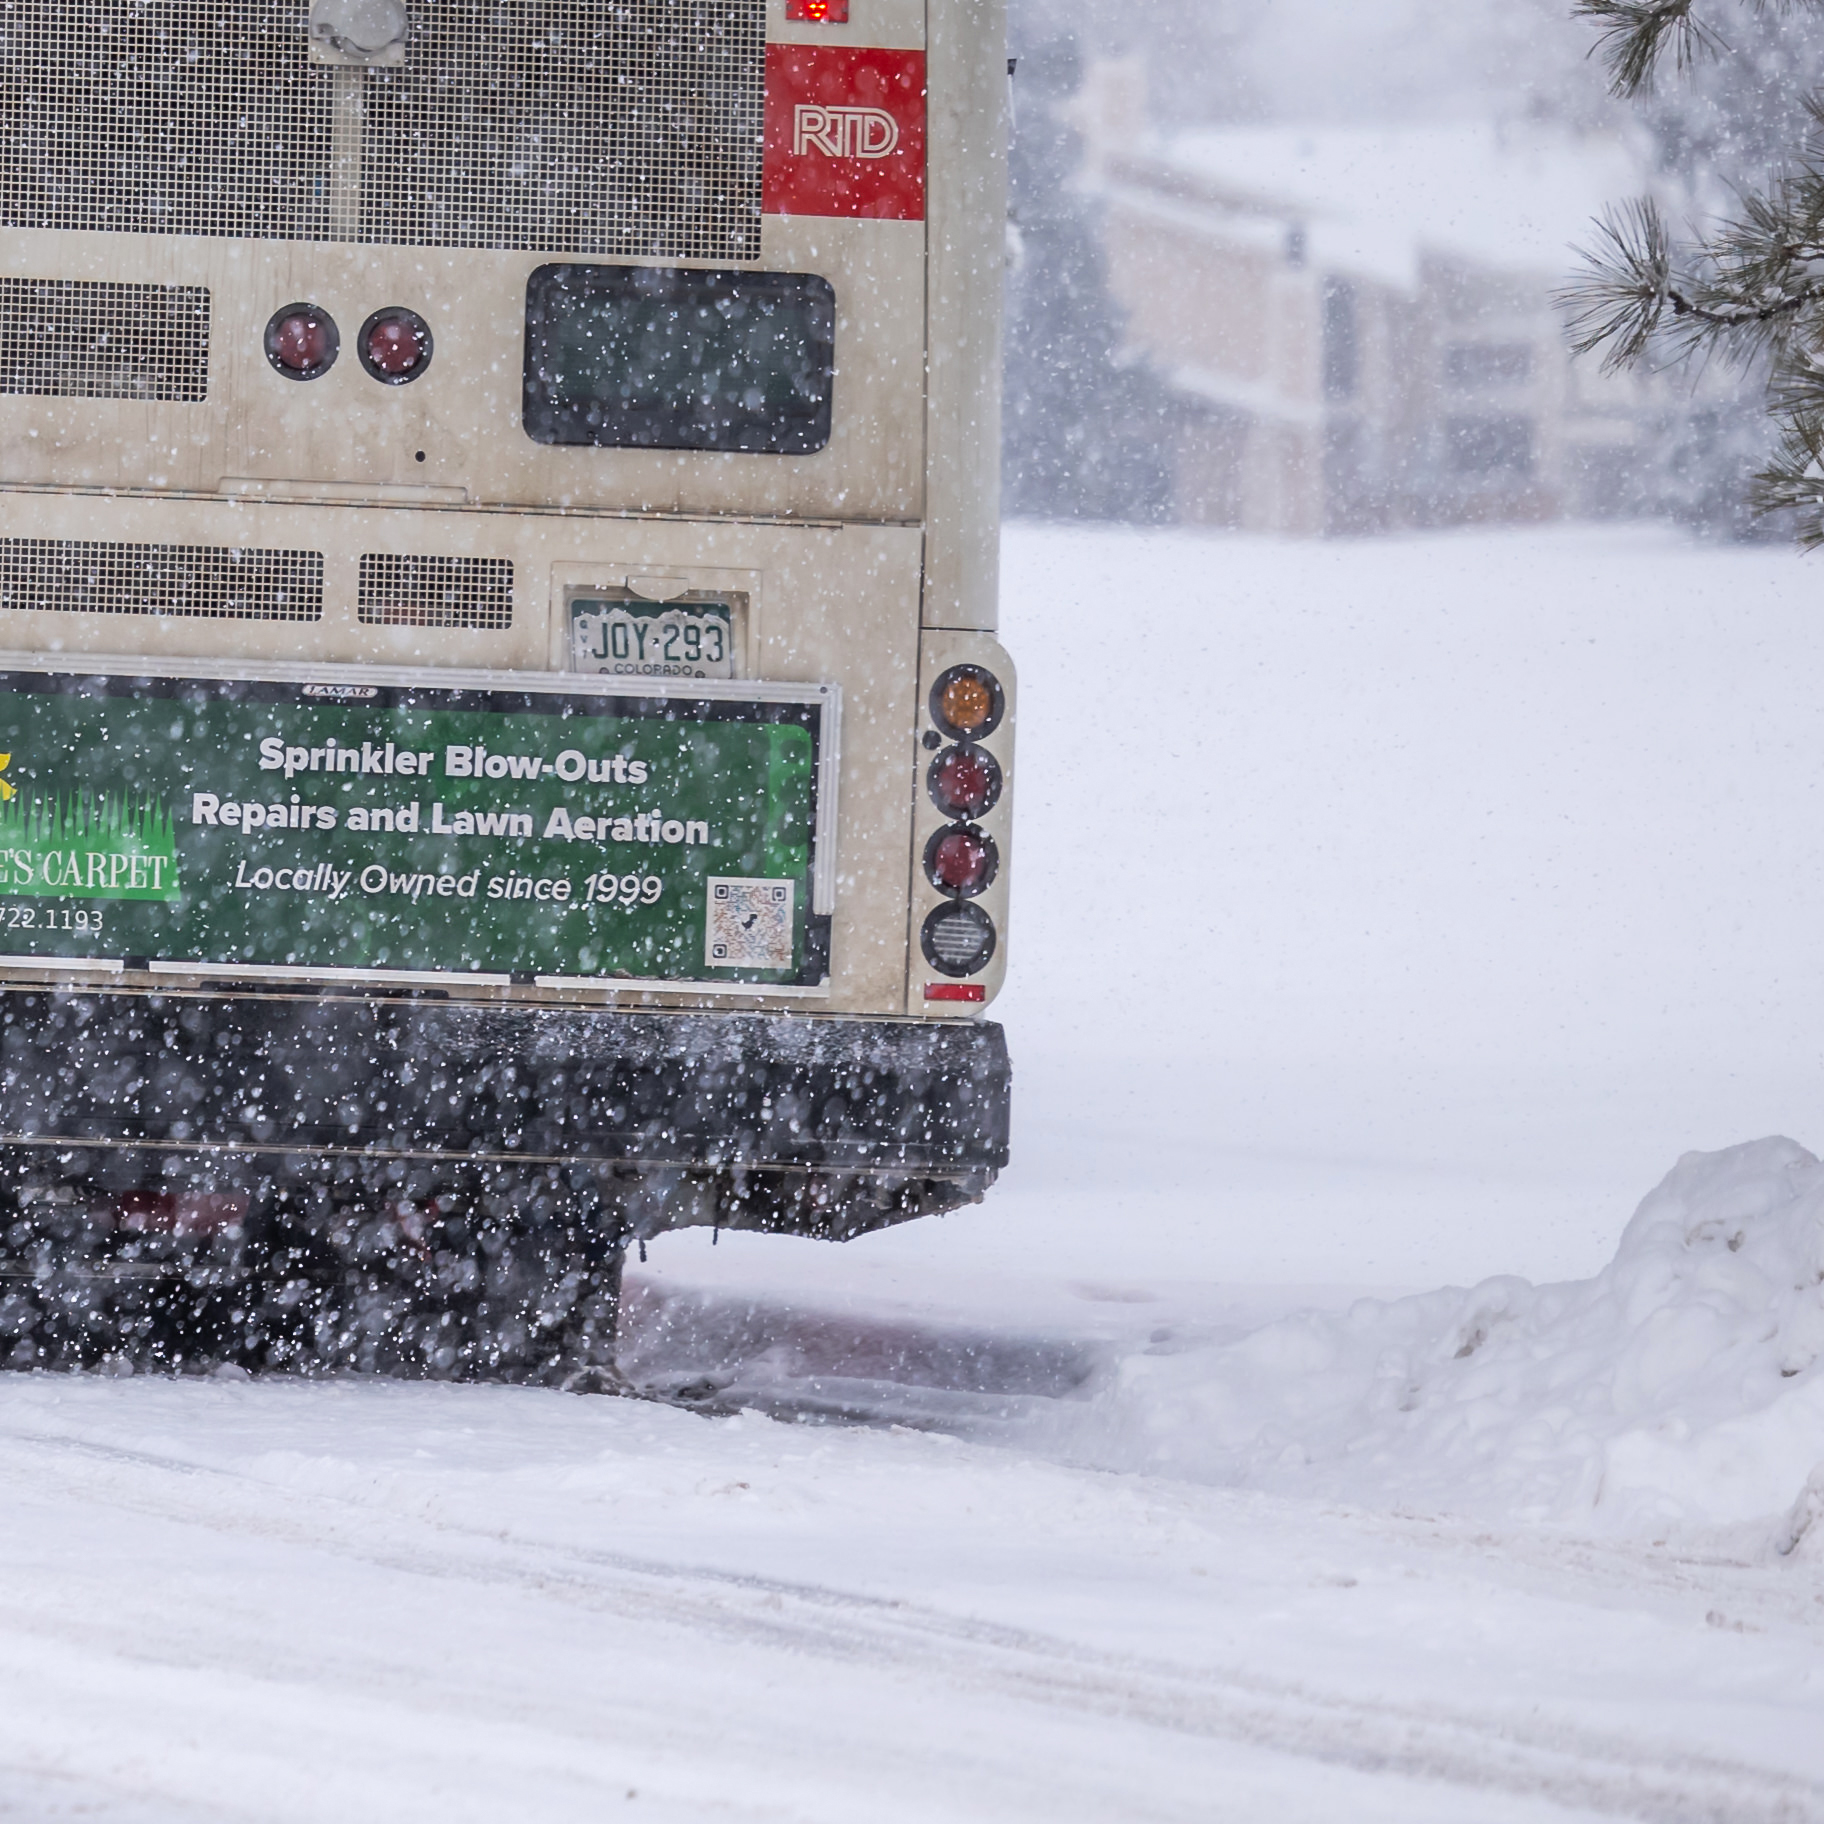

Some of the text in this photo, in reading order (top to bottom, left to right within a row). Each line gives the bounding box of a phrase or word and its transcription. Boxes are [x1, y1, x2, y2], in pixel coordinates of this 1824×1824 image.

[794, 104, 899, 159] RTD
[615, 663, 692, 676] COLORADO
[259, 737, 648, 785] Sprinkler Blow-Outs
[192, 792, 710, 845] Repairs and Lawn Aeration
[43, 850, 169, 890] CARPET
[235, 860, 663, 905] Locally Owned since 1999
